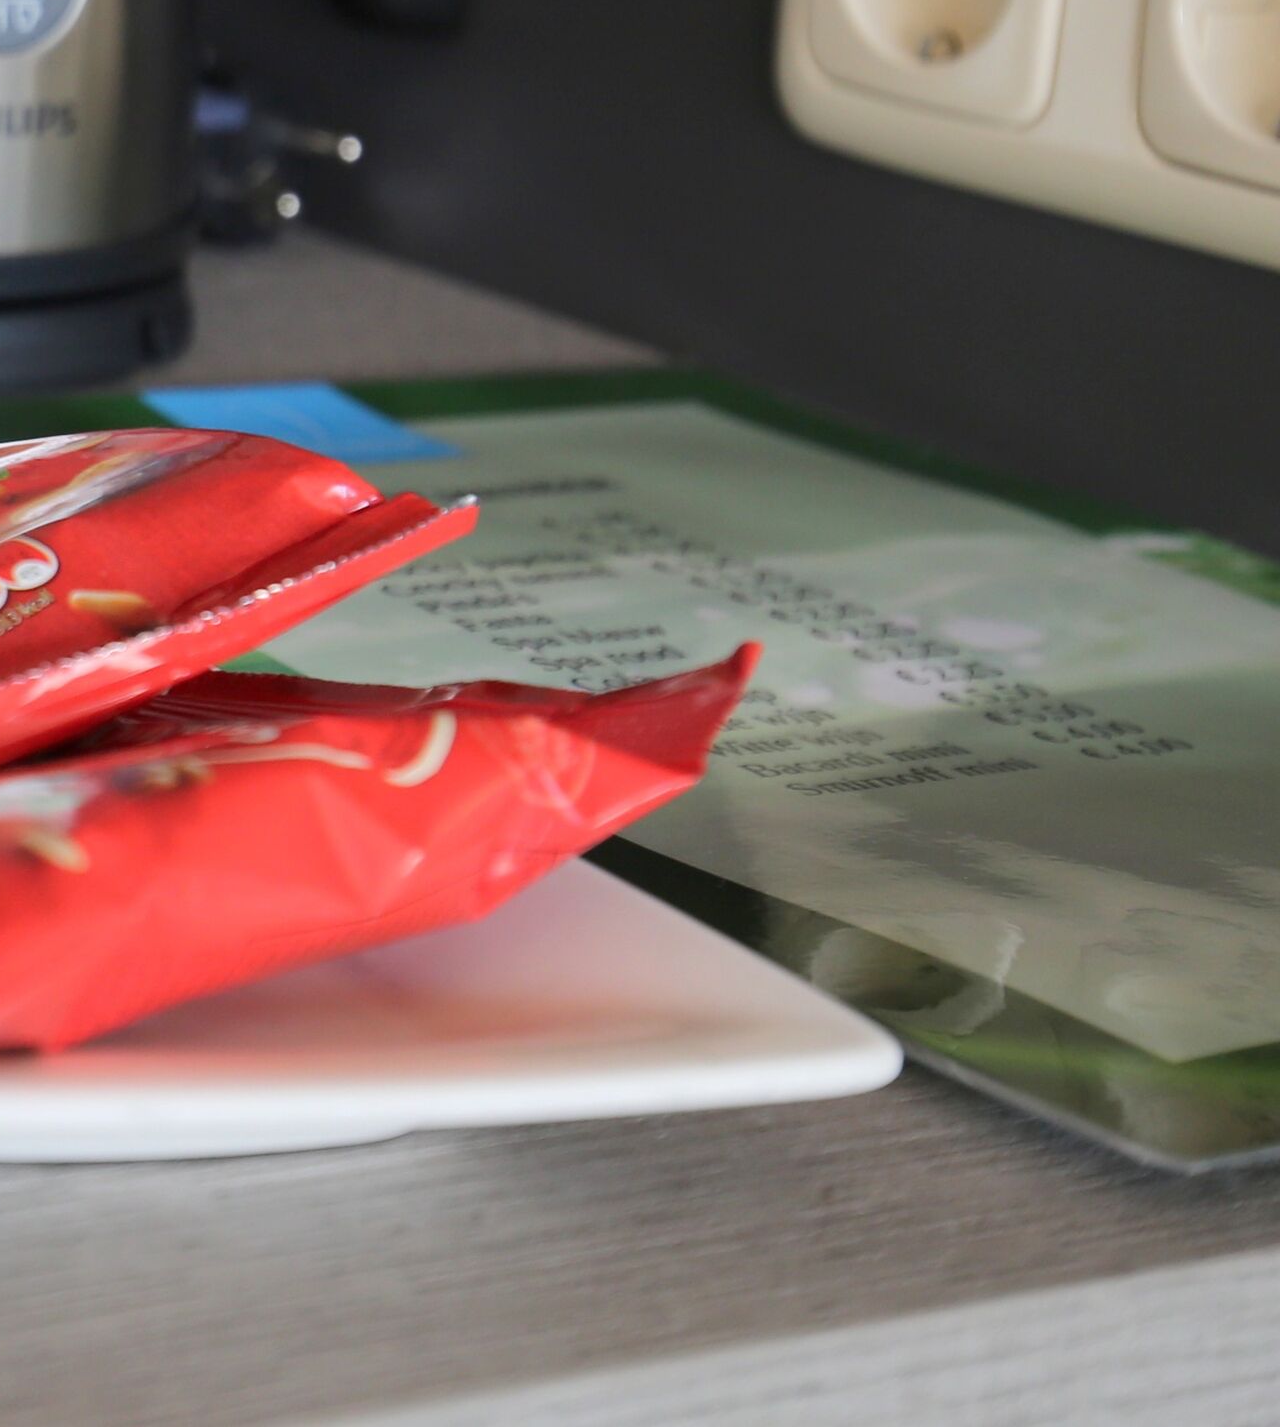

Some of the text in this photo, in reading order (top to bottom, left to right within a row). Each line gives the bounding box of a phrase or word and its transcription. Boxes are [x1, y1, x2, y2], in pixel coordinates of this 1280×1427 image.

[529, 652, 604, 673] Spa
[708, 735, 799, 759] Witte
[799, 727, 886, 748] wijn
[739, 750, 886, 779] Bacardi
[885, 739, 972, 762] mini
[786, 765, 953, 797] Smirnoff
[952, 756, 1041, 778] mini
